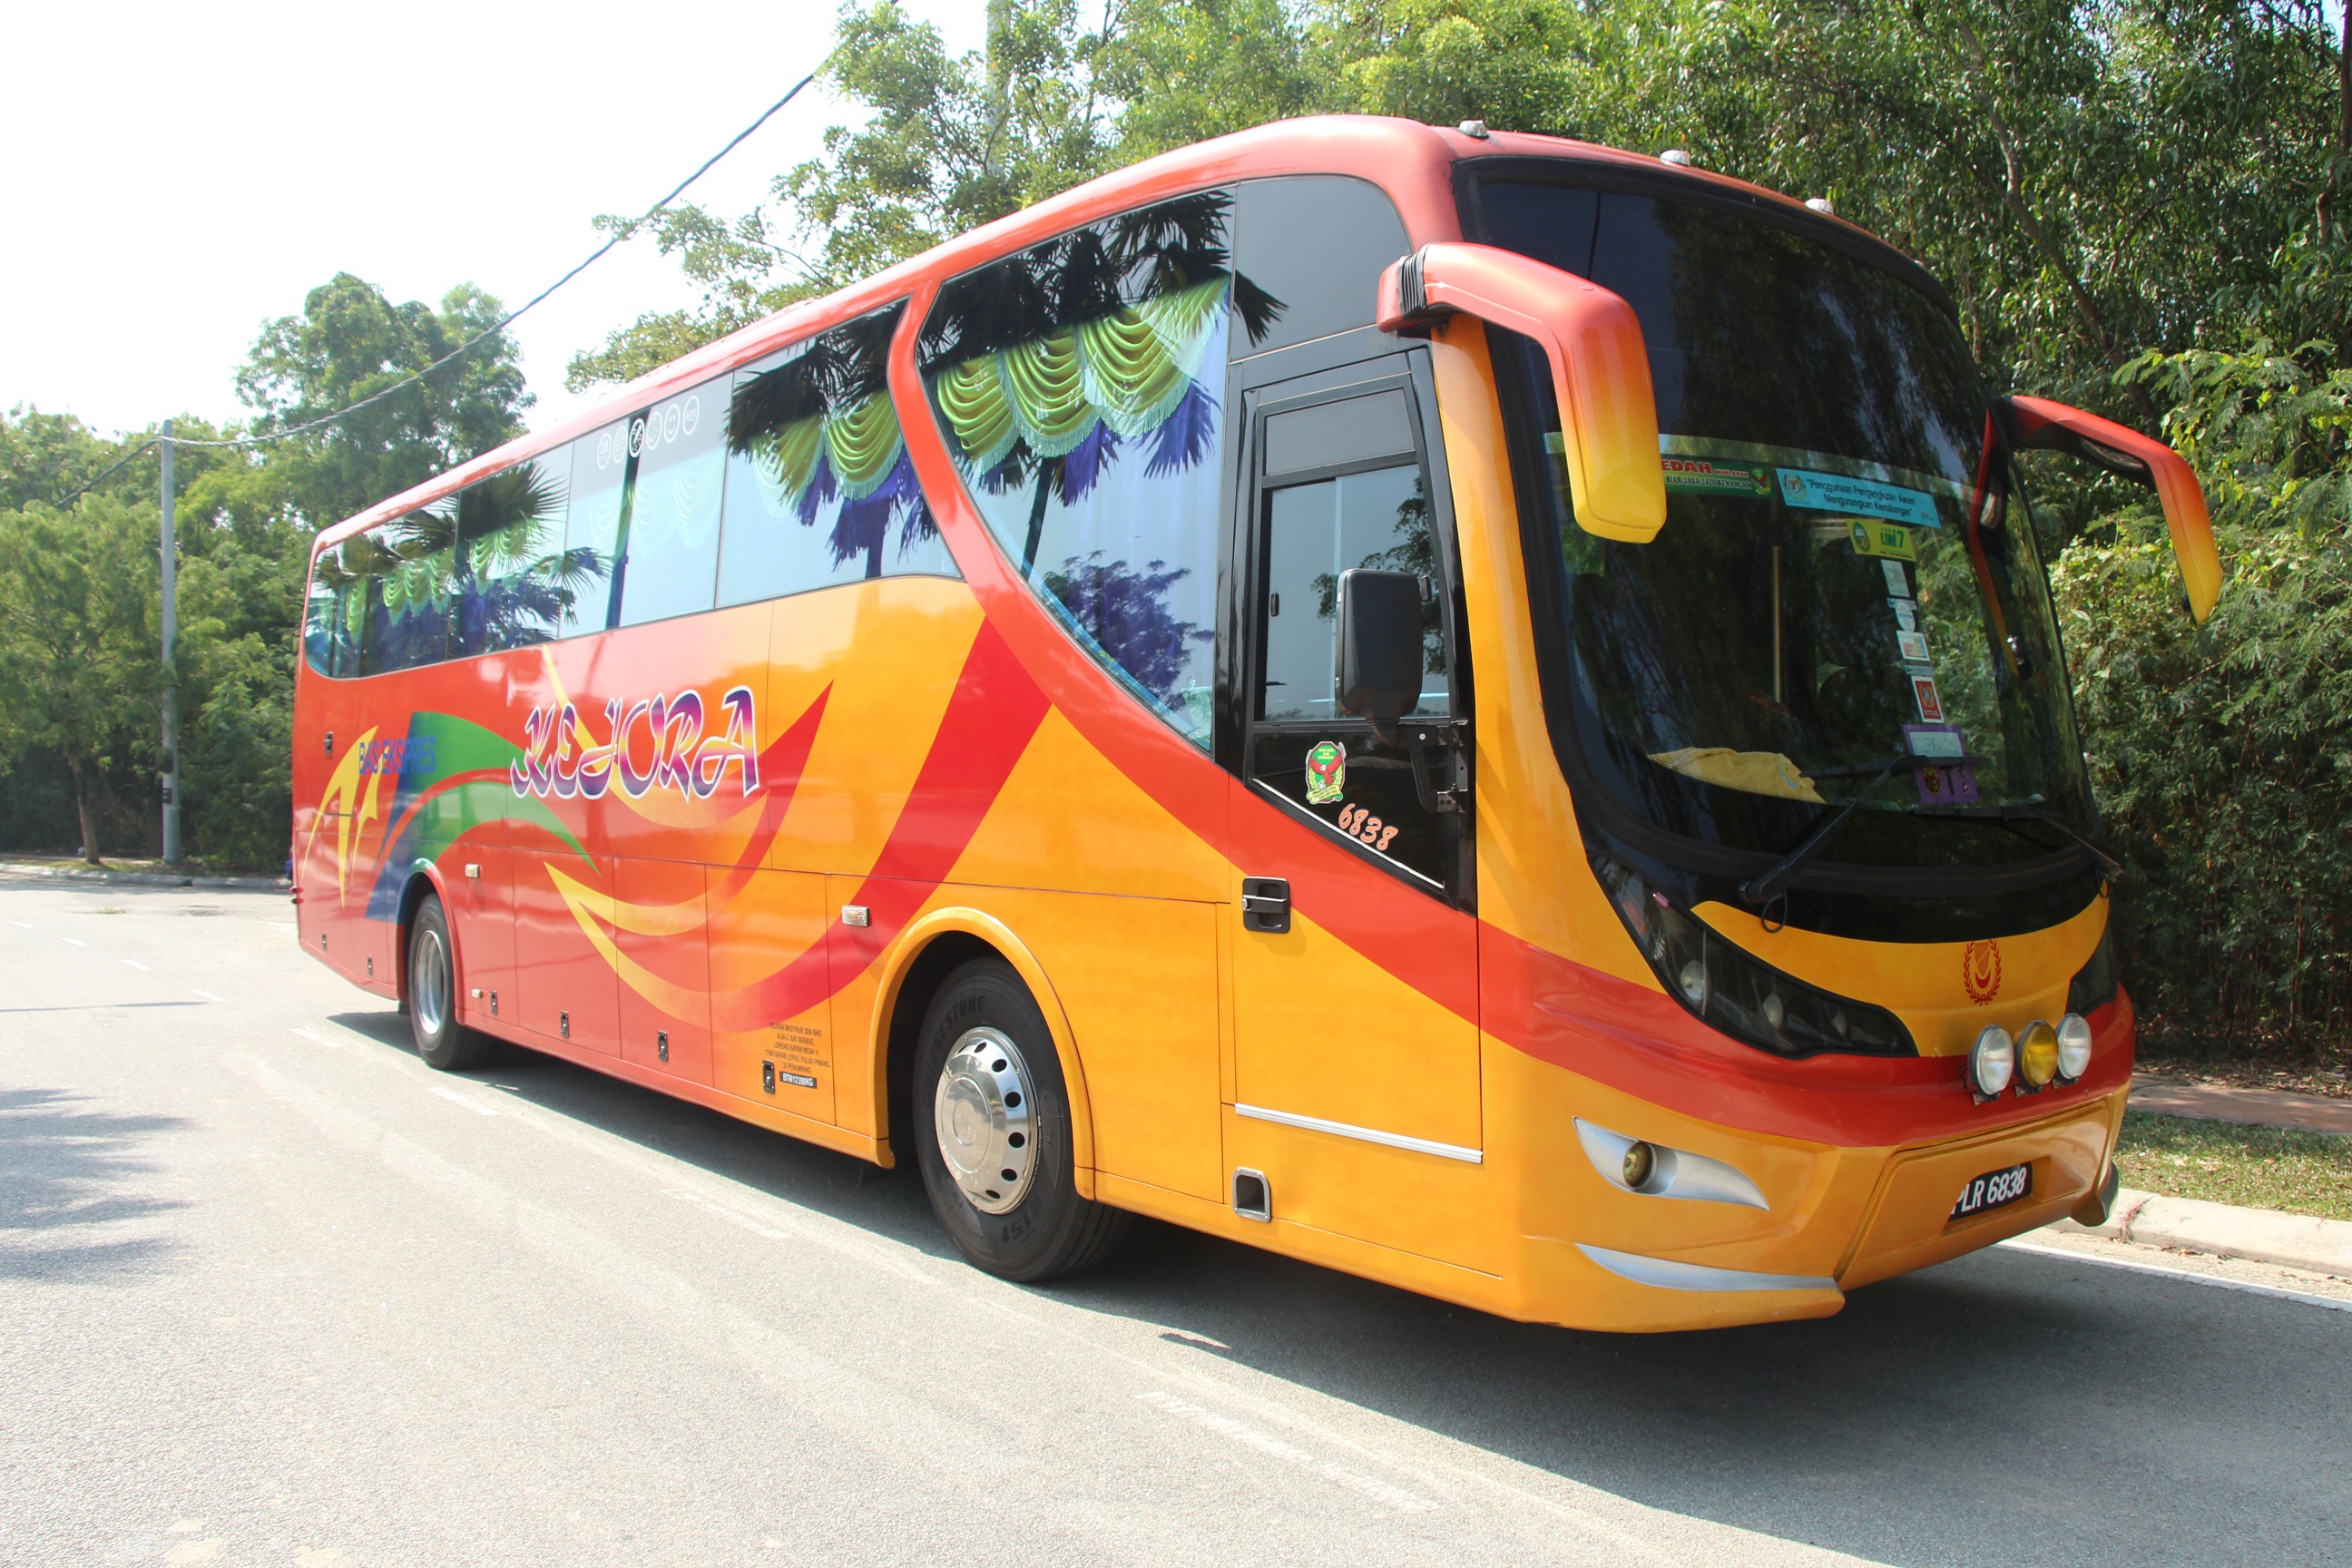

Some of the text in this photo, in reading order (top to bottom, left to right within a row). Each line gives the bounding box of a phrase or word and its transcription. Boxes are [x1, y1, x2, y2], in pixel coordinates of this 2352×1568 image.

[1666, 475, 1752, 489] BIAR JASA JADI KENANGAN
[1824, 493, 1873, 509] Mengurangkan
[1853, 485, 1896, 501] Pengangkutan
[358, 736, 436, 775] BAS EKSPRES
[510, 684, 760, 804] KEJORA
[1338, 803, 1398, 850] 6838
[1987, 1167, 2027, 1205] 6838
